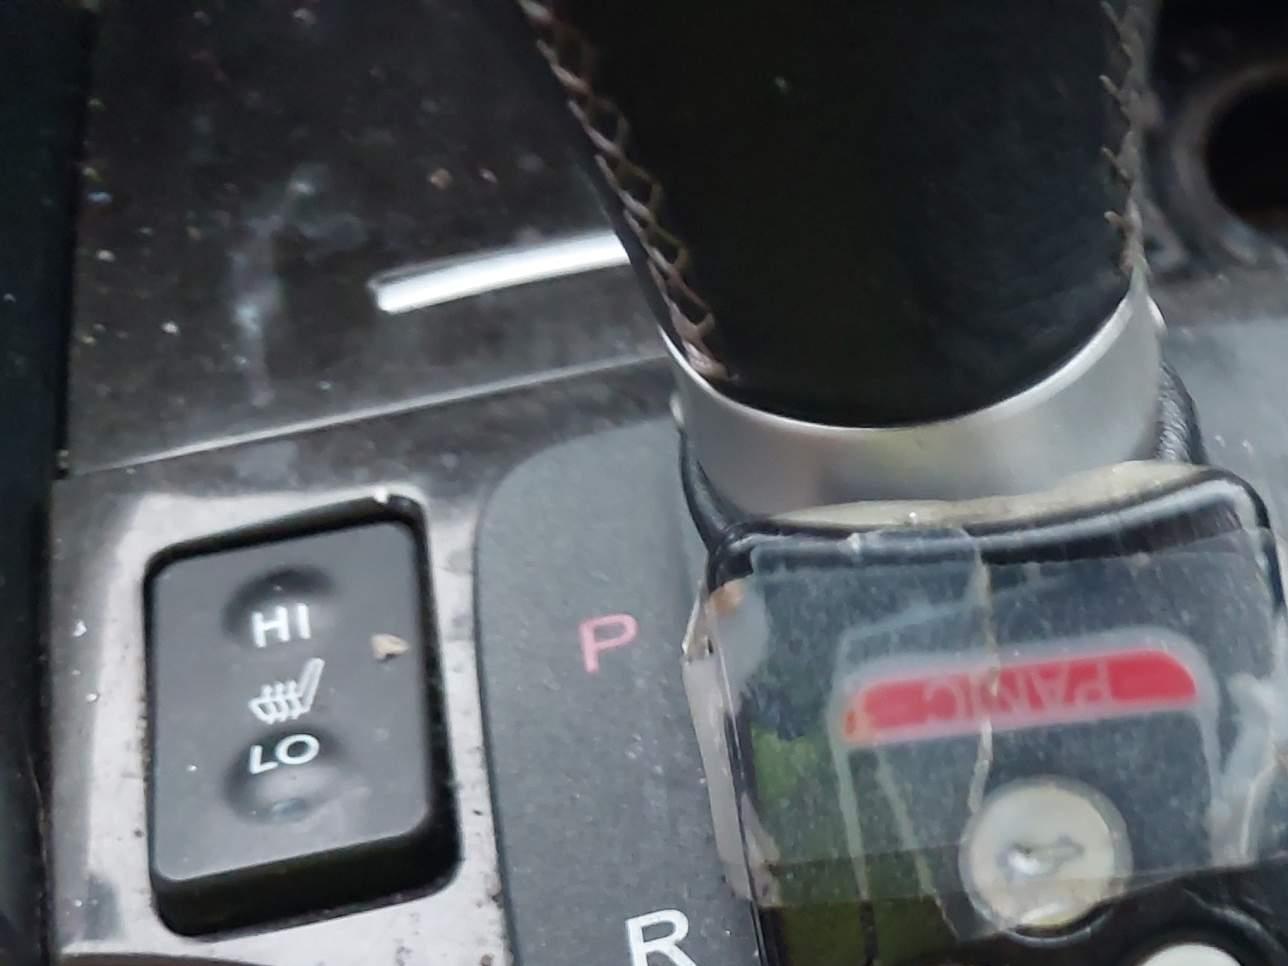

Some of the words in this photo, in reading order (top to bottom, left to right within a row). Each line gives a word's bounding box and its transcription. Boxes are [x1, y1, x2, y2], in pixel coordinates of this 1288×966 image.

[251, 602, 312, 648] HI
[578, 613, 638, 674] P
[926, 657, 1113, 723] PANIC
[249, 733, 321, 775] LO
